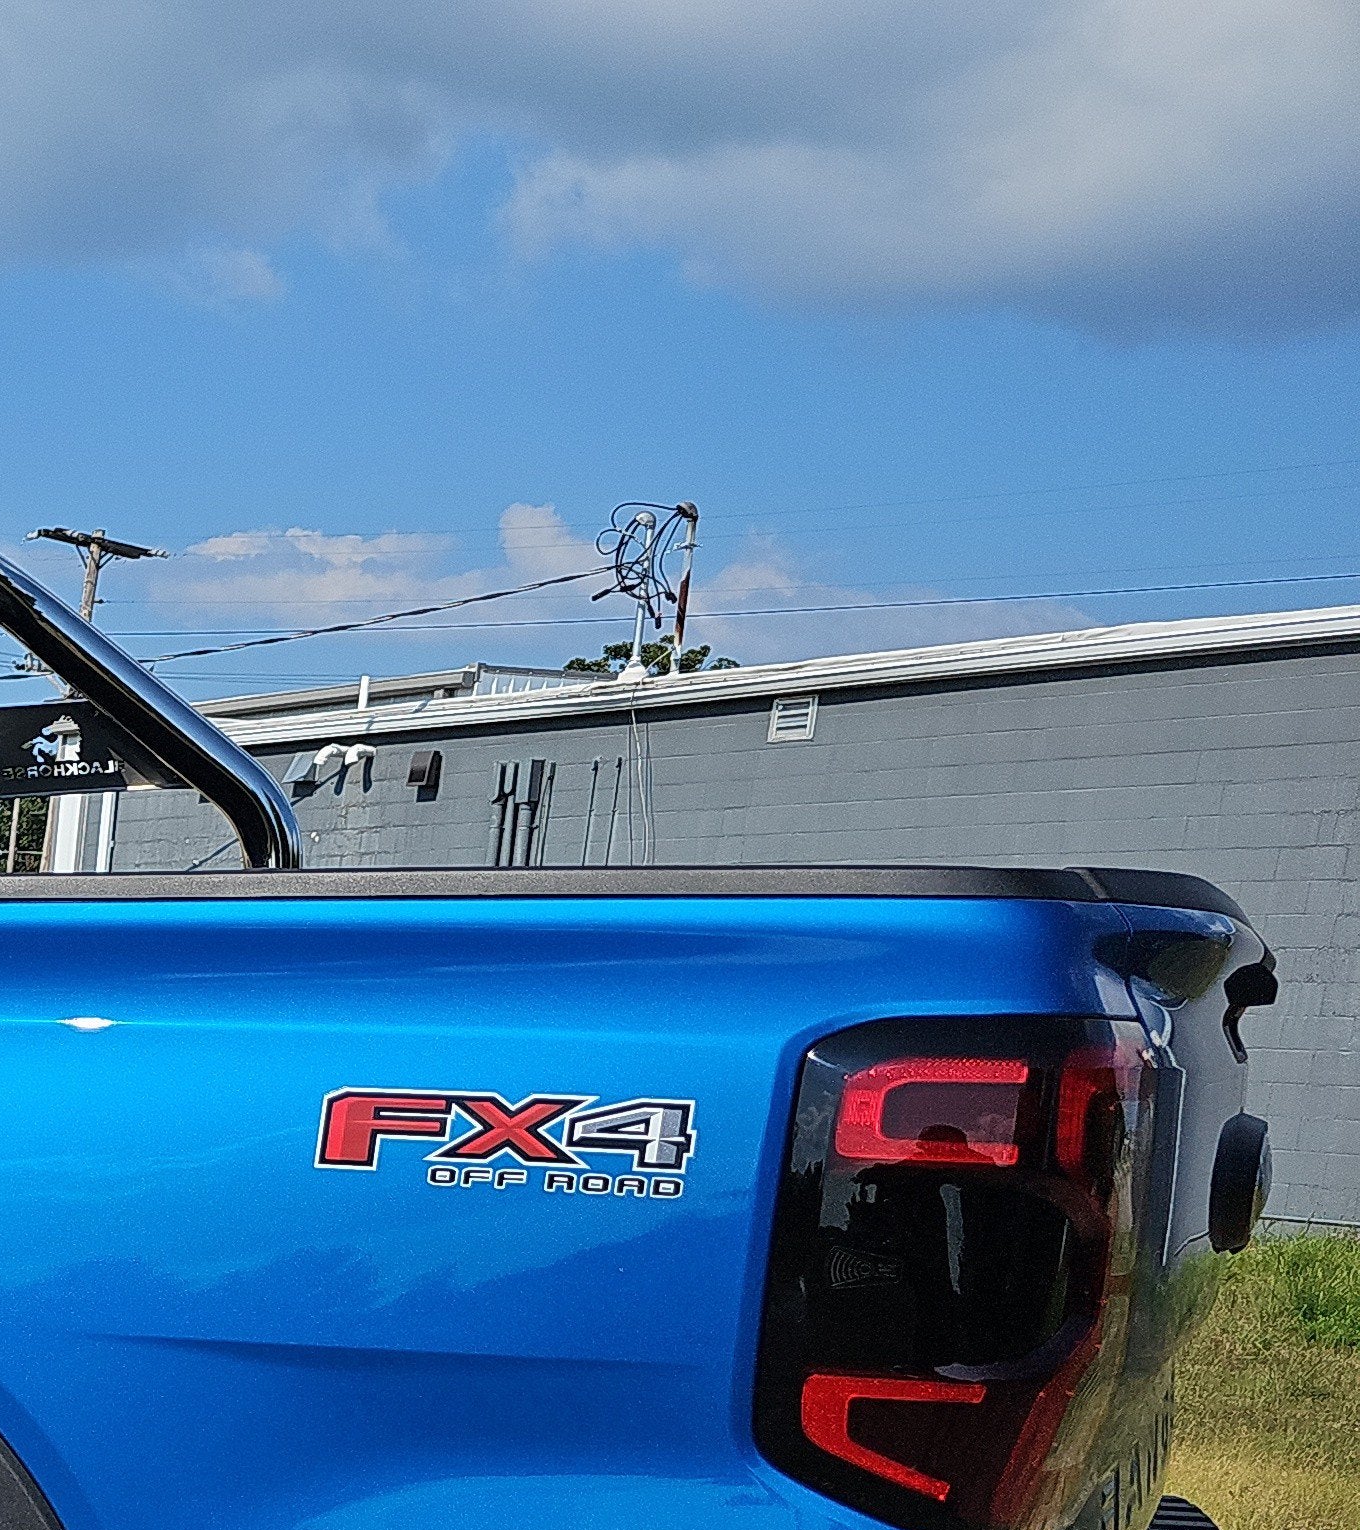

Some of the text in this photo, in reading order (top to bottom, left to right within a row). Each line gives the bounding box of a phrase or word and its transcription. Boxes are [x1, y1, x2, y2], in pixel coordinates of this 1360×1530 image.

[314, 1086, 697, 1174] FX4
[426, 1165, 684, 1199] OFF ROAD
